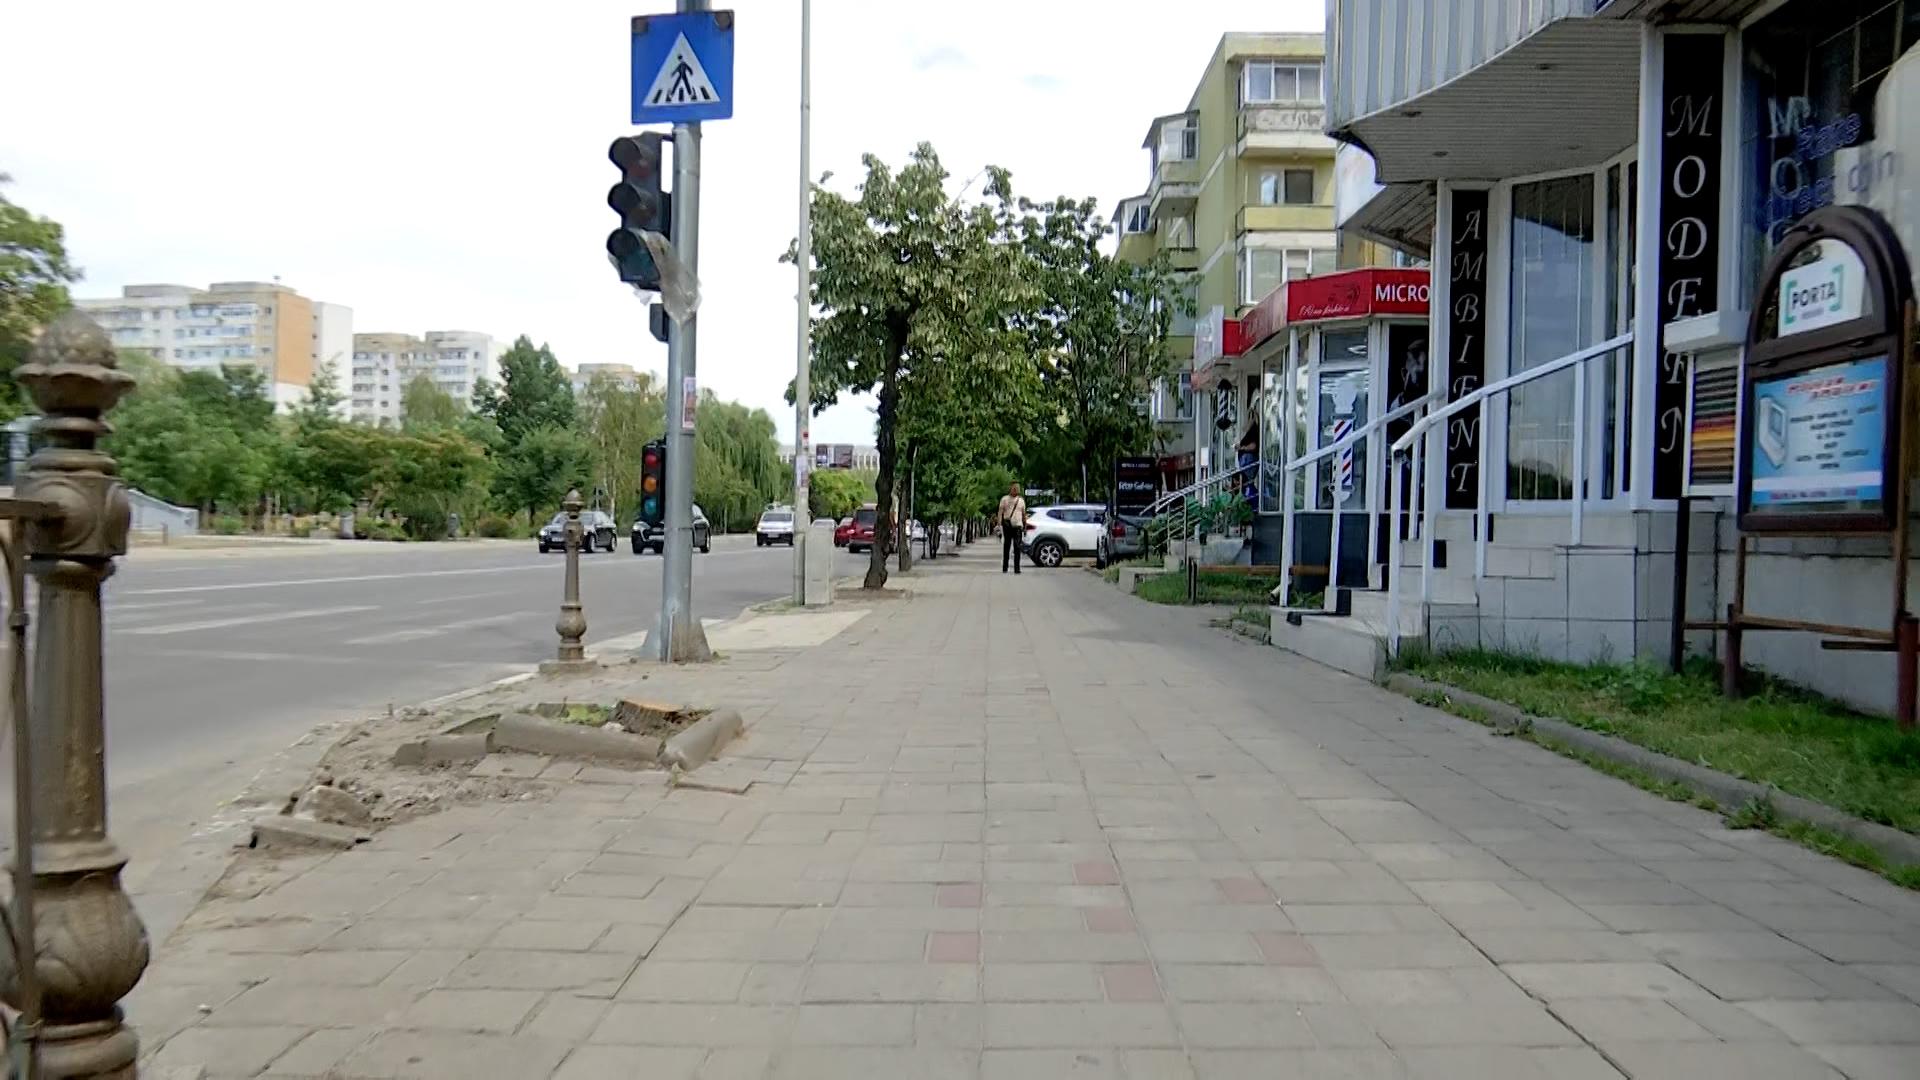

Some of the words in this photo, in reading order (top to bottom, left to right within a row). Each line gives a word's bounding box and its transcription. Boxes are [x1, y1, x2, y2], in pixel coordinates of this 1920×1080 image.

[1375, 283, 1430, 303] MICRO
[1791, 281, 1836, 310] PORTA
[1449, 209, 1485, 493] AMBIENT
